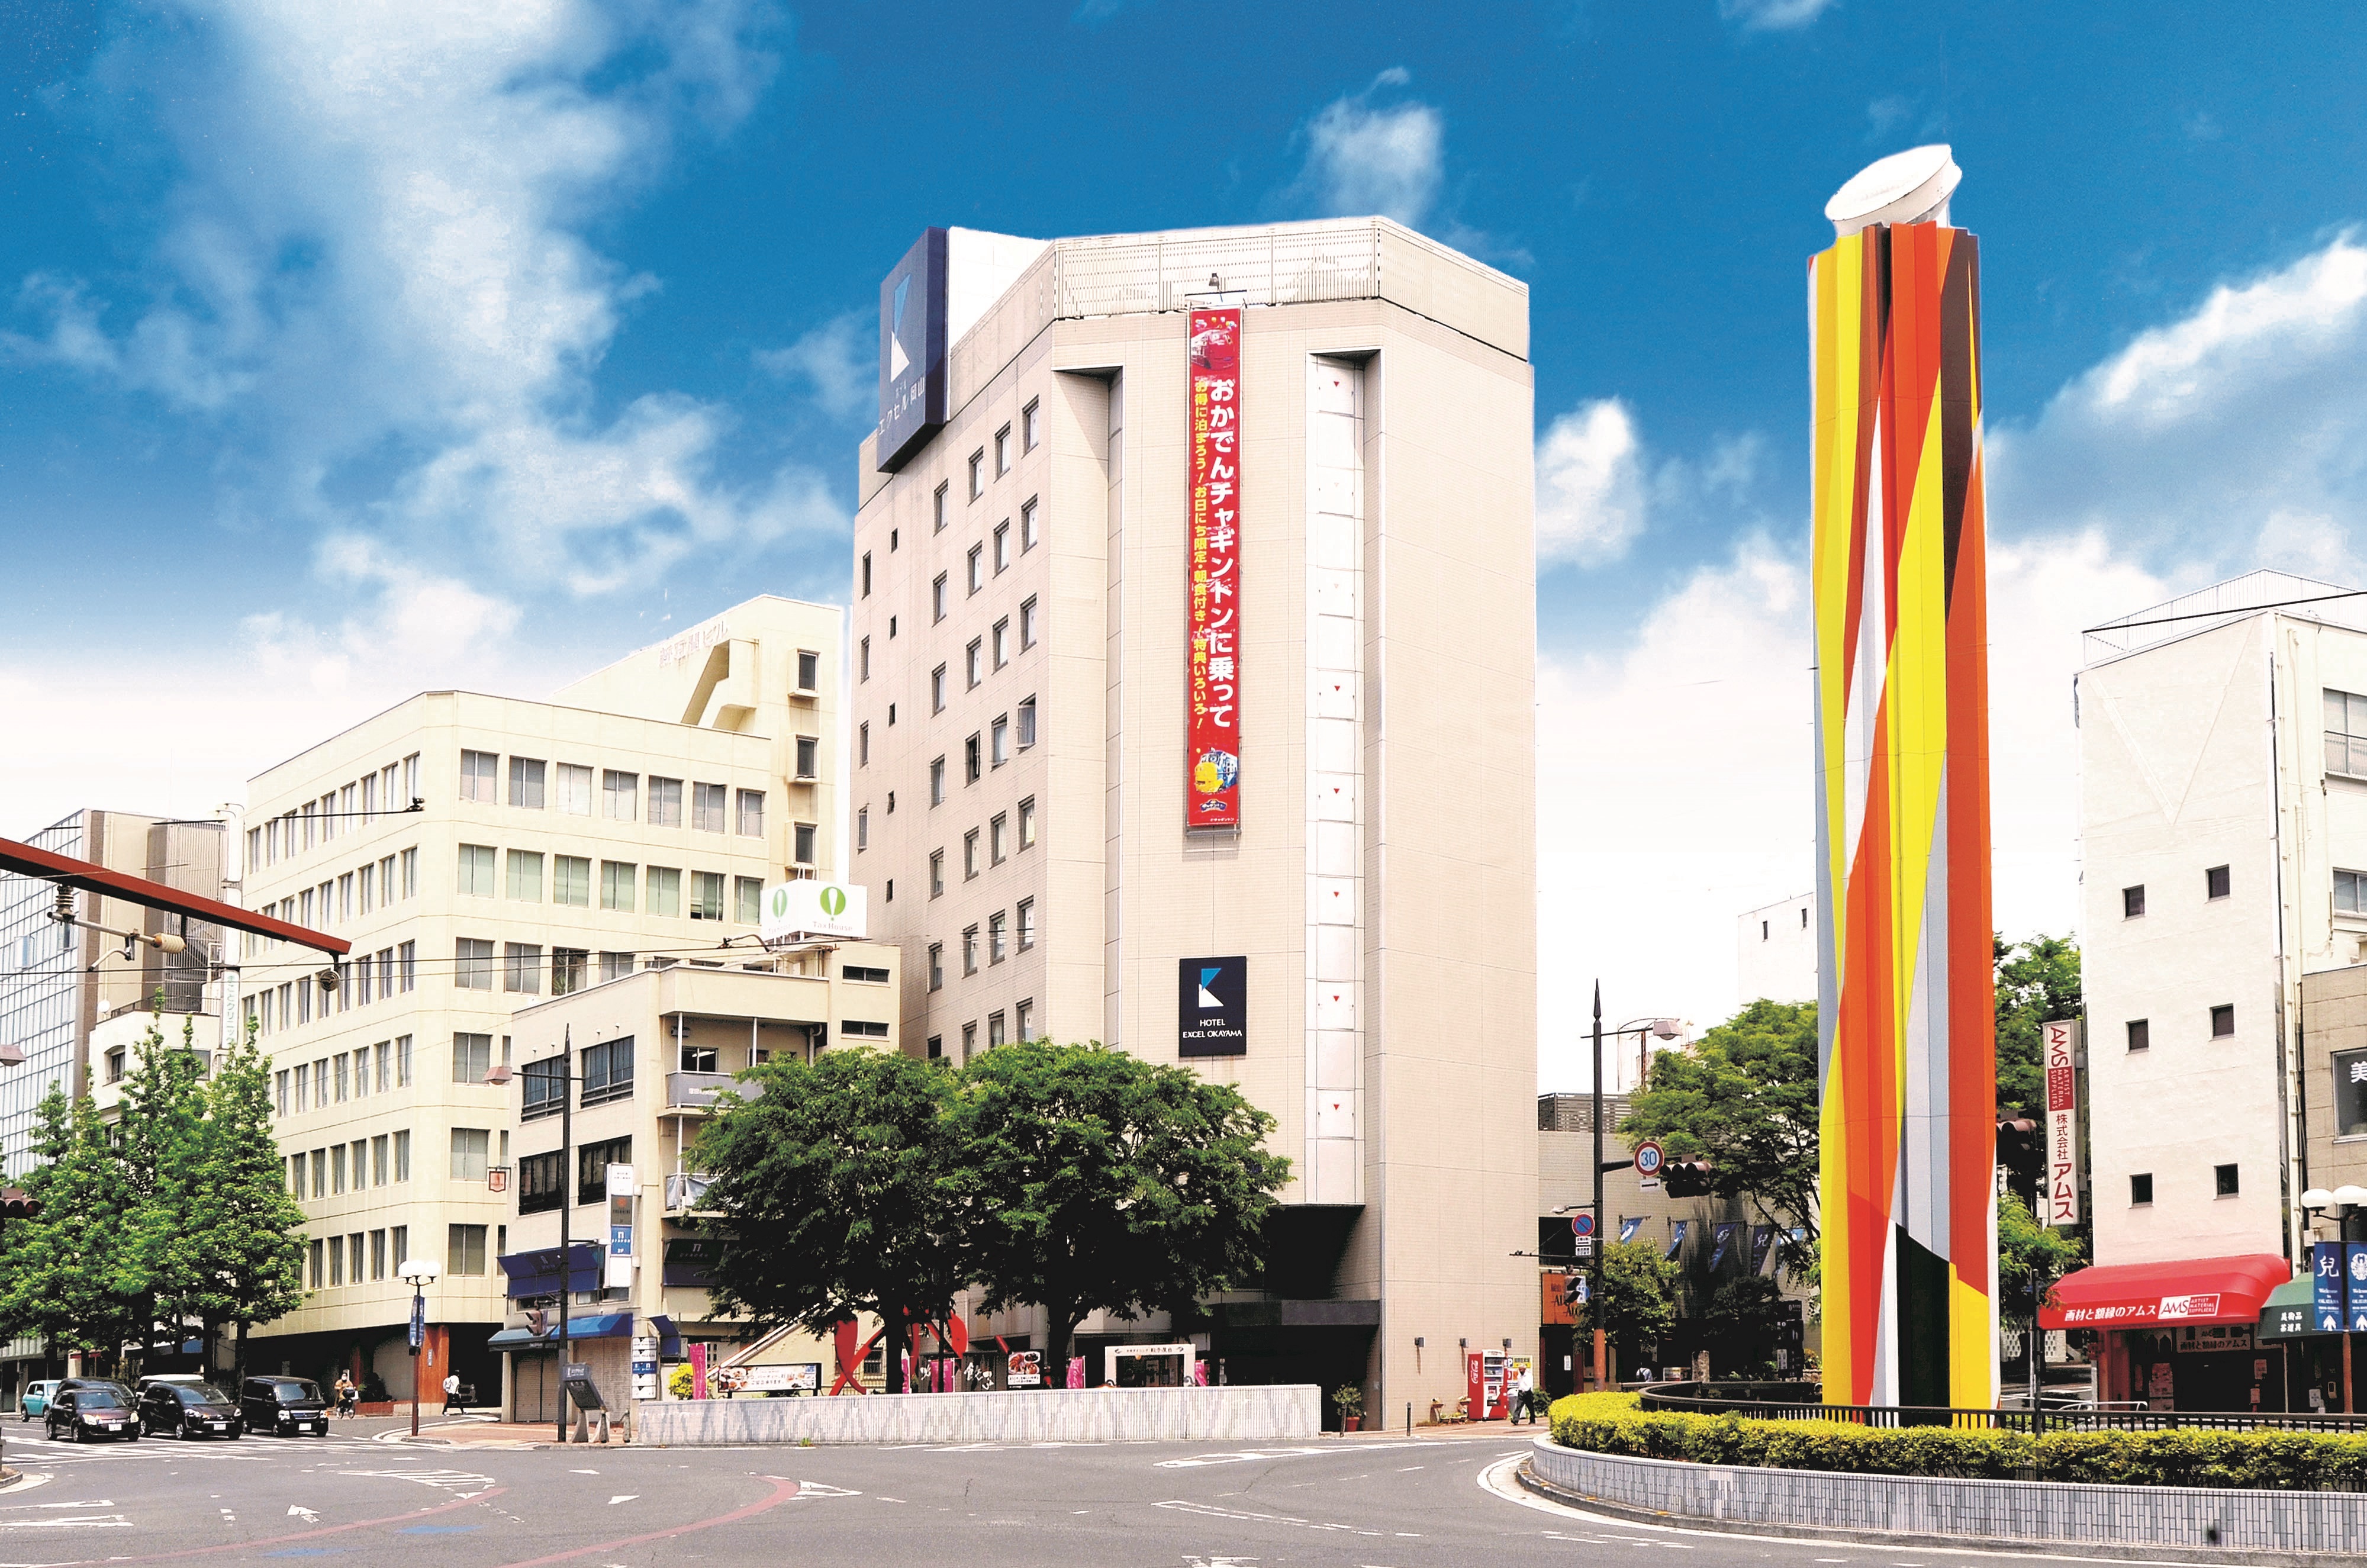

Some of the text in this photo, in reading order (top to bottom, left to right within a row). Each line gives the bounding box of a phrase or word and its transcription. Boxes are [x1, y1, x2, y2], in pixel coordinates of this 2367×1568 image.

[879, 376, 925, 436] エクセル岡山
[1200, 1019, 1225, 1027] HOTEL
[2050, 1026, 2068, 1067] AMS
[1641, 1151, 1657, 1167] 30
[2065, 1305, 2156, 1322] 画材と額縁のアムス
[2160, 1300, 2189, 1315] AMS
